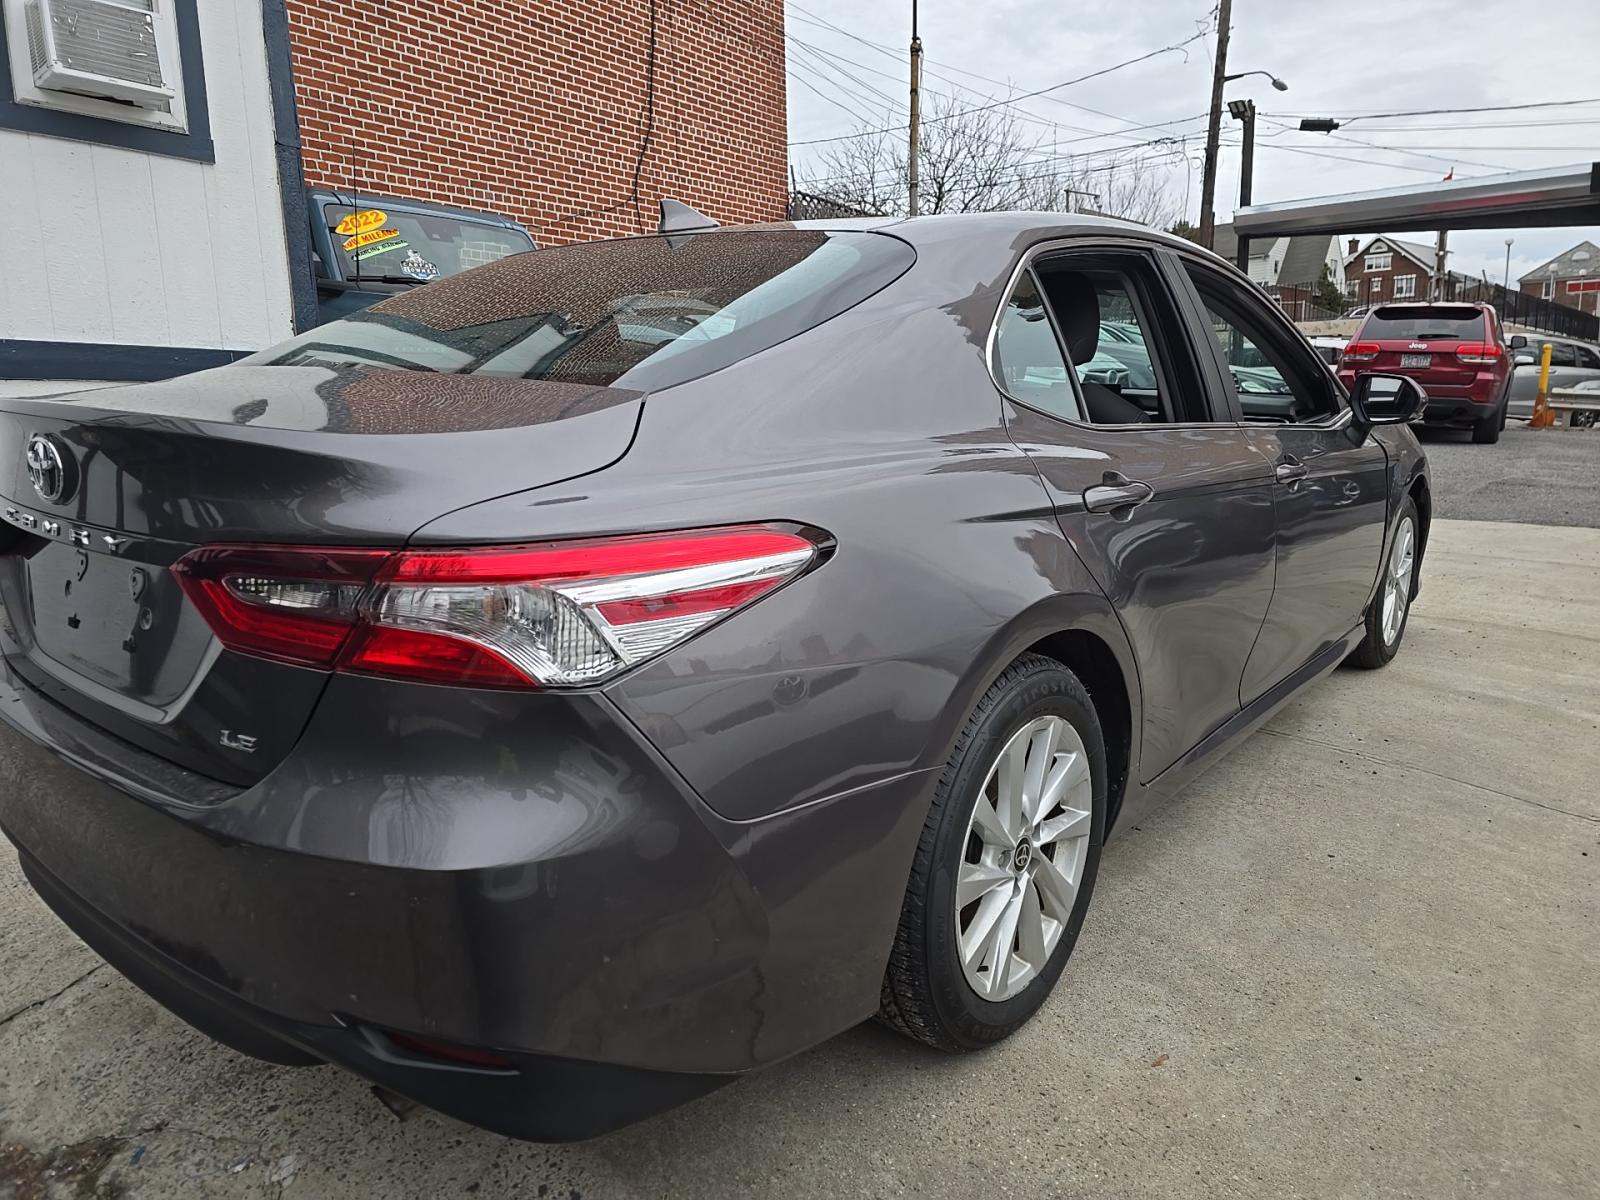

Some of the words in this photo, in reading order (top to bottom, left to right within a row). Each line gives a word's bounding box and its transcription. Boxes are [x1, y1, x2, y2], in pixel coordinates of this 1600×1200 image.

[342, 211, 383, 233] 2022
[1408, 342, 1428, 350] Jeep
[6, 506, 128, 551] CAMRY
[219, 729, 257, 754] LE
